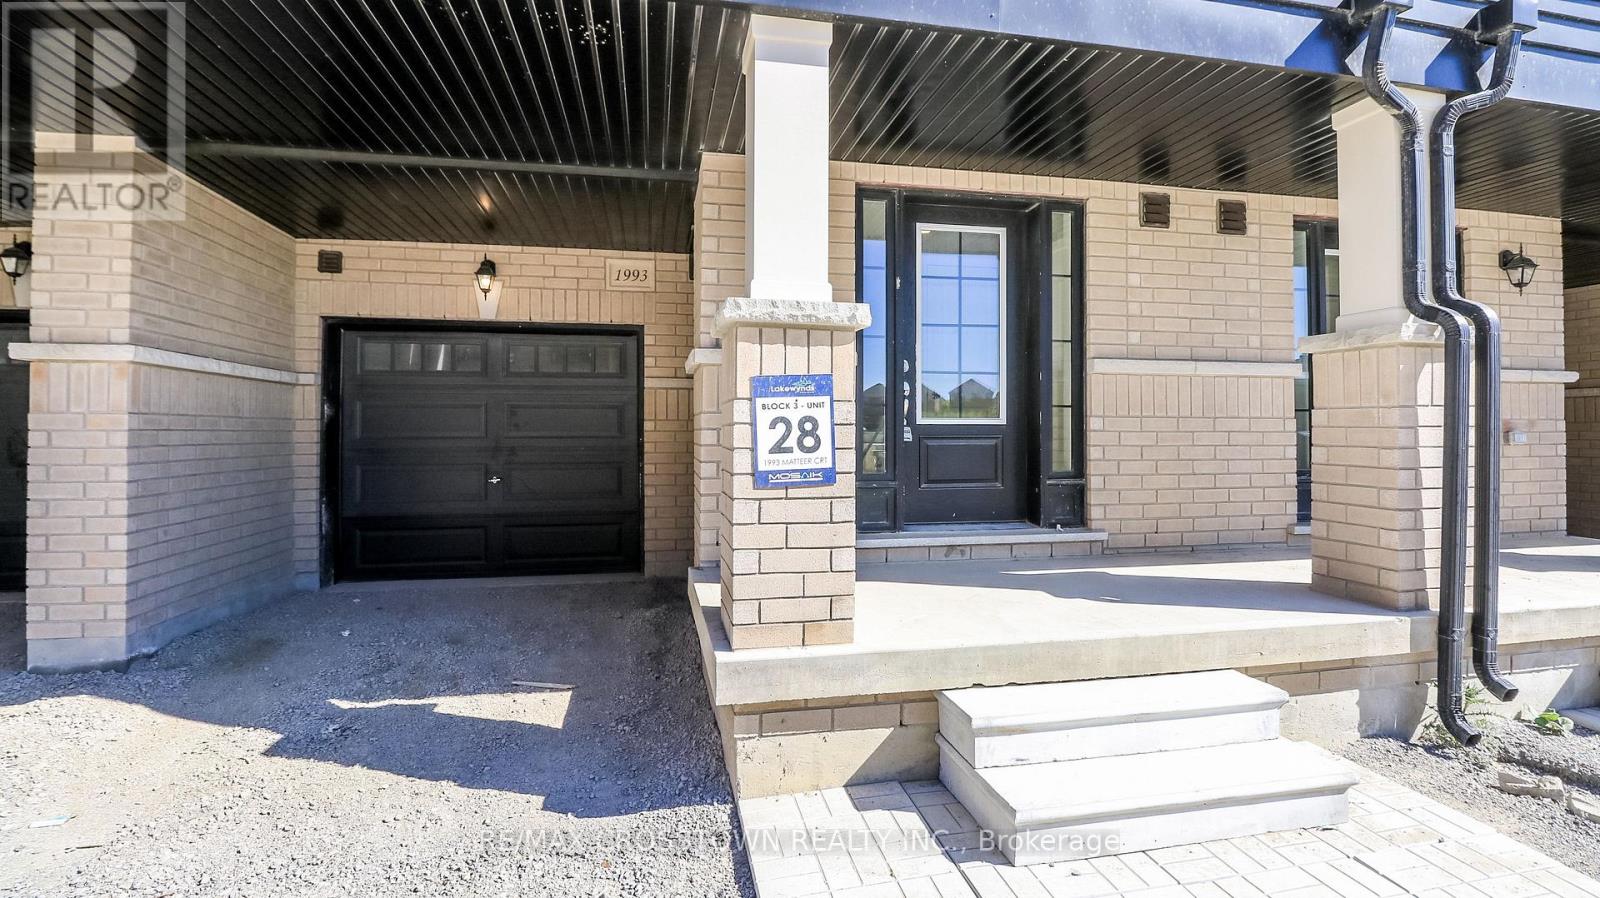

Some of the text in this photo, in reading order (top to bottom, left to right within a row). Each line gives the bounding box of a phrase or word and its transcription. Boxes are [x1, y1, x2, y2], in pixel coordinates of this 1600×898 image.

[614, 268, 648, 282] 1993
[770, 384, 815, 394] Lakewynds
[761, 402, 791, 410] BLOCK
[806, 401, 825, 409] UNIT
[768, 415, 822, 454] 28
[764, 456, 828, 467] 1993 MATTEER CRT
